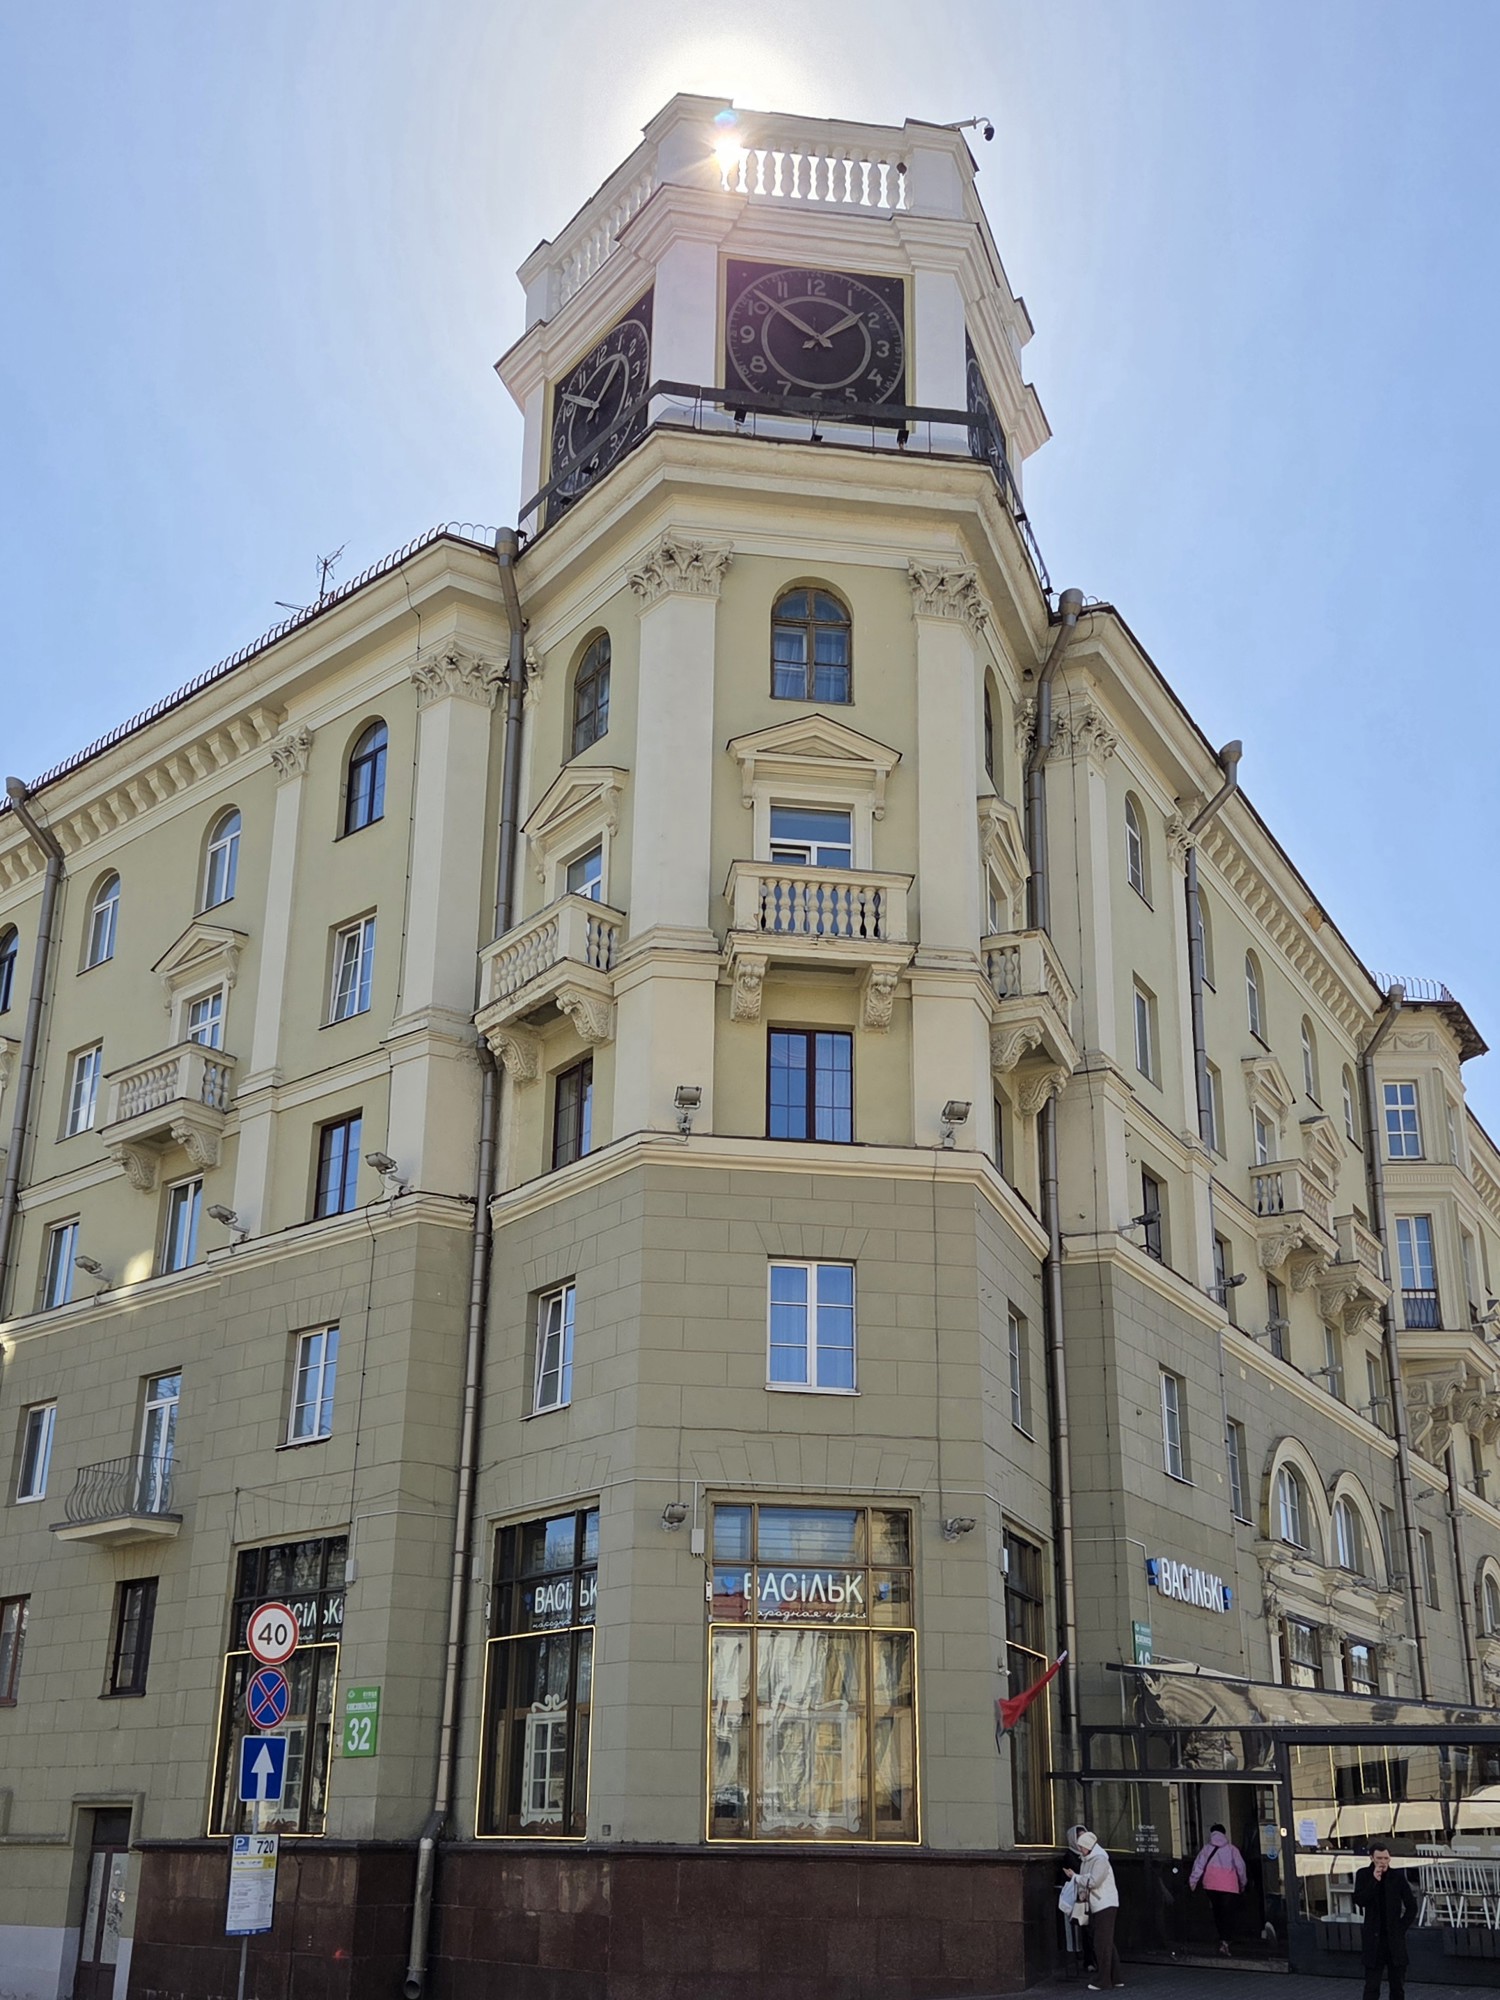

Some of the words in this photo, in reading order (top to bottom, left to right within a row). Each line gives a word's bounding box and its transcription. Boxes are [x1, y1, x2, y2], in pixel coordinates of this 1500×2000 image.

[777, 280, 789, 299] 11
[807, 278, 827, 297] 12
[847, 289, 853, 307] 1
[748, 299, 770, 317] 10
[868, 312, 881, 329] 2
[617, 333, 624, 351] 1
[740, 325, 755, 344] 9
[596, 345, 608, 368] 12
[628, 338, 637, 358] 2
[876, 340, 890, 358] 3
[631, 360, 641, 380] 3
[750, 355, 768, 374] 8
[579, 368, 587, 390] 11
[867, 368, 883, 388] 4
[777, 380, 792, 396] 7
[845, 387, 858, 402] 5
[624, 392, 634, 410] 4
[562, 402, 574, 424] 10
[557, 434, 566, 456] 9
[743, 1572, 864, 1604] ВАСіЛЬК
[257, 1622, 288, 1646] 40
[347, 1717, 371, 1751] 32
[256, 1840, 275, 1854] 720
